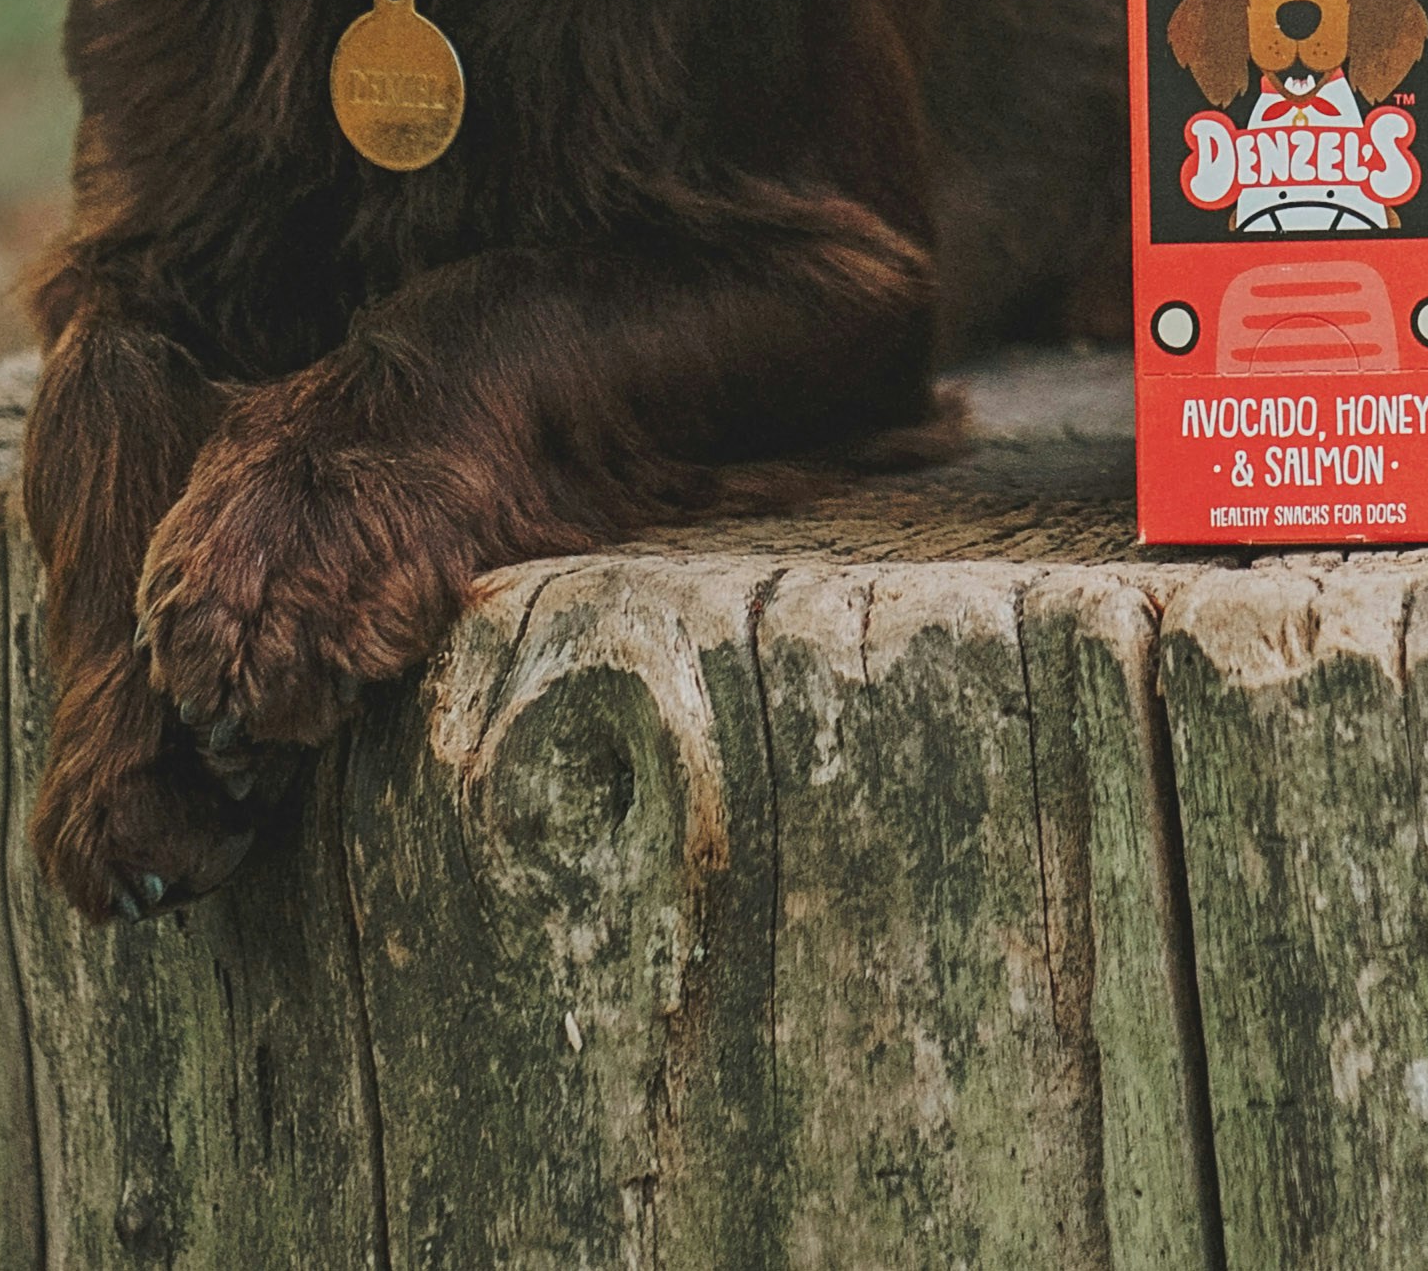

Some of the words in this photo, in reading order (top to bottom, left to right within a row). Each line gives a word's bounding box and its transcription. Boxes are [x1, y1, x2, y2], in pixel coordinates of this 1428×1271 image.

[1393, 93, 1415, 106] TM
[1189, 113, 1413, 202] DENZEL'S
[1181, 396, 1327, 442] AVOCADO,
[1230, 450, 1255, 487] &
[1264, 445, 1384, 487] SALMON
[1210, 506, 1270, 528] HEALTHY
[1274, 504, 1329, 526] SNACKS
[1334, 504, 1362, 525] FOR
[1366, 503, 1407, 524] DOGS
